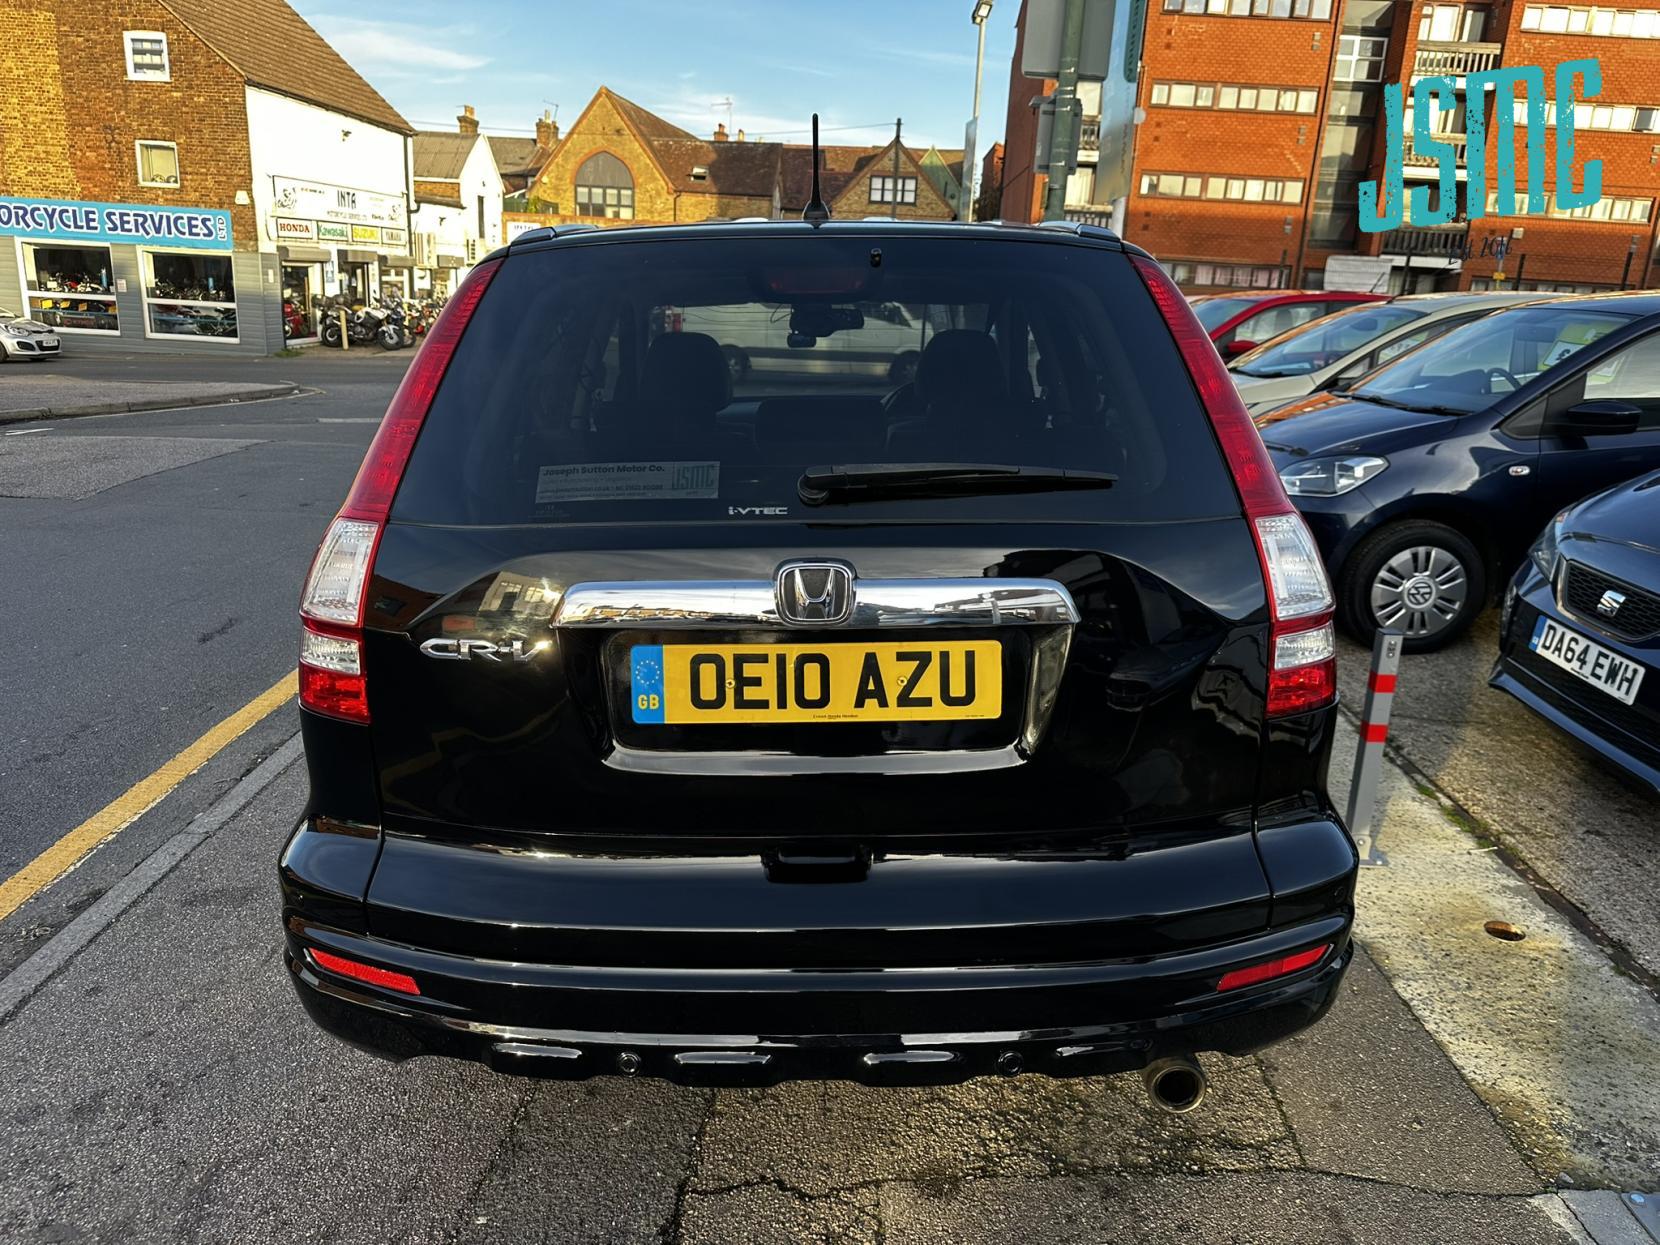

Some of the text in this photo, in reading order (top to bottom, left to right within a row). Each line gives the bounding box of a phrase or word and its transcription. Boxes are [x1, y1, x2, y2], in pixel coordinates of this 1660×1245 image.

[337, 189, 357, 209] INTA
[0, 204, 227, 240] ORCYCLE SERVICES LTD
[279, 222, 310, 233] HONDA
[319, 224, 348, 237] Kawasaki
[353, 227, 379, 240] SUZUKI
[543, 464, 665, 477] Joseph Sutton Motor Co.
[672, 464, 715, 489] JSMC
[1541, 623, 1639, 697] DA64 EWH
[689, 650, 976, 711] OE10 AZU
[637, 694, 660, 710] GB
